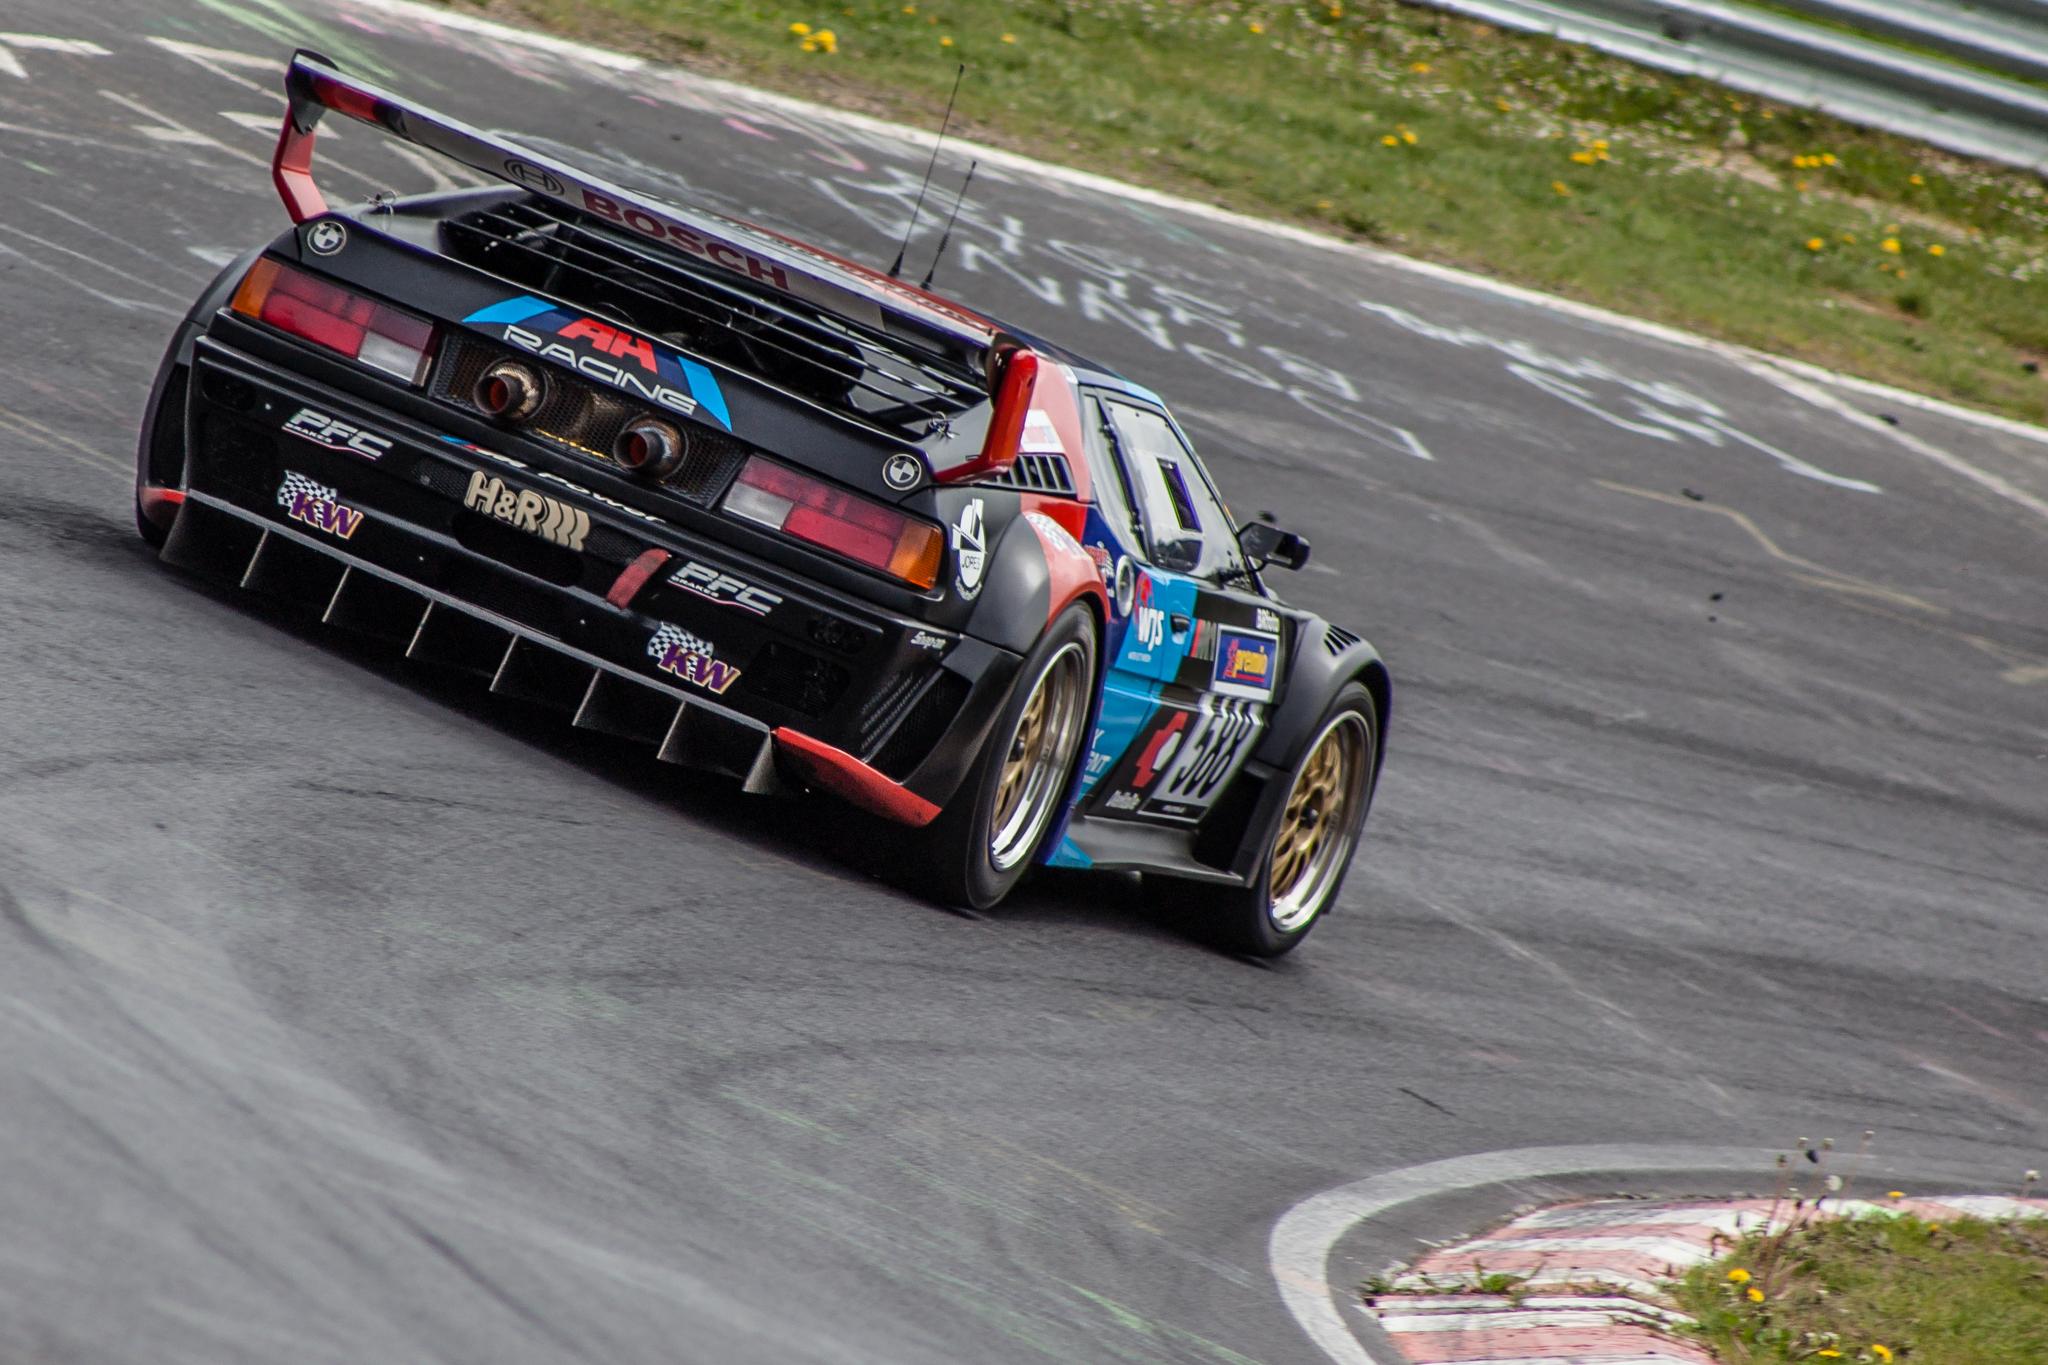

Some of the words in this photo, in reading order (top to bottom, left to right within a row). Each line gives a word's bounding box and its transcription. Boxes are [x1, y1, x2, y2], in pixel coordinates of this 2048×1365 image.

[581, 188, 790, 291] BOSCH
[502, 324, 698, 416] RACING
[556, 316, 660, 374] AH
[289, 408, 394, 457] PFC
[288, 491, 364, 540] KW
[464, 470, 548, 534] H&R
[670, 574, 720, 598] BRAKES
[675, 560, 784, 614] PFC
[657, 641, 742, 696] KW
